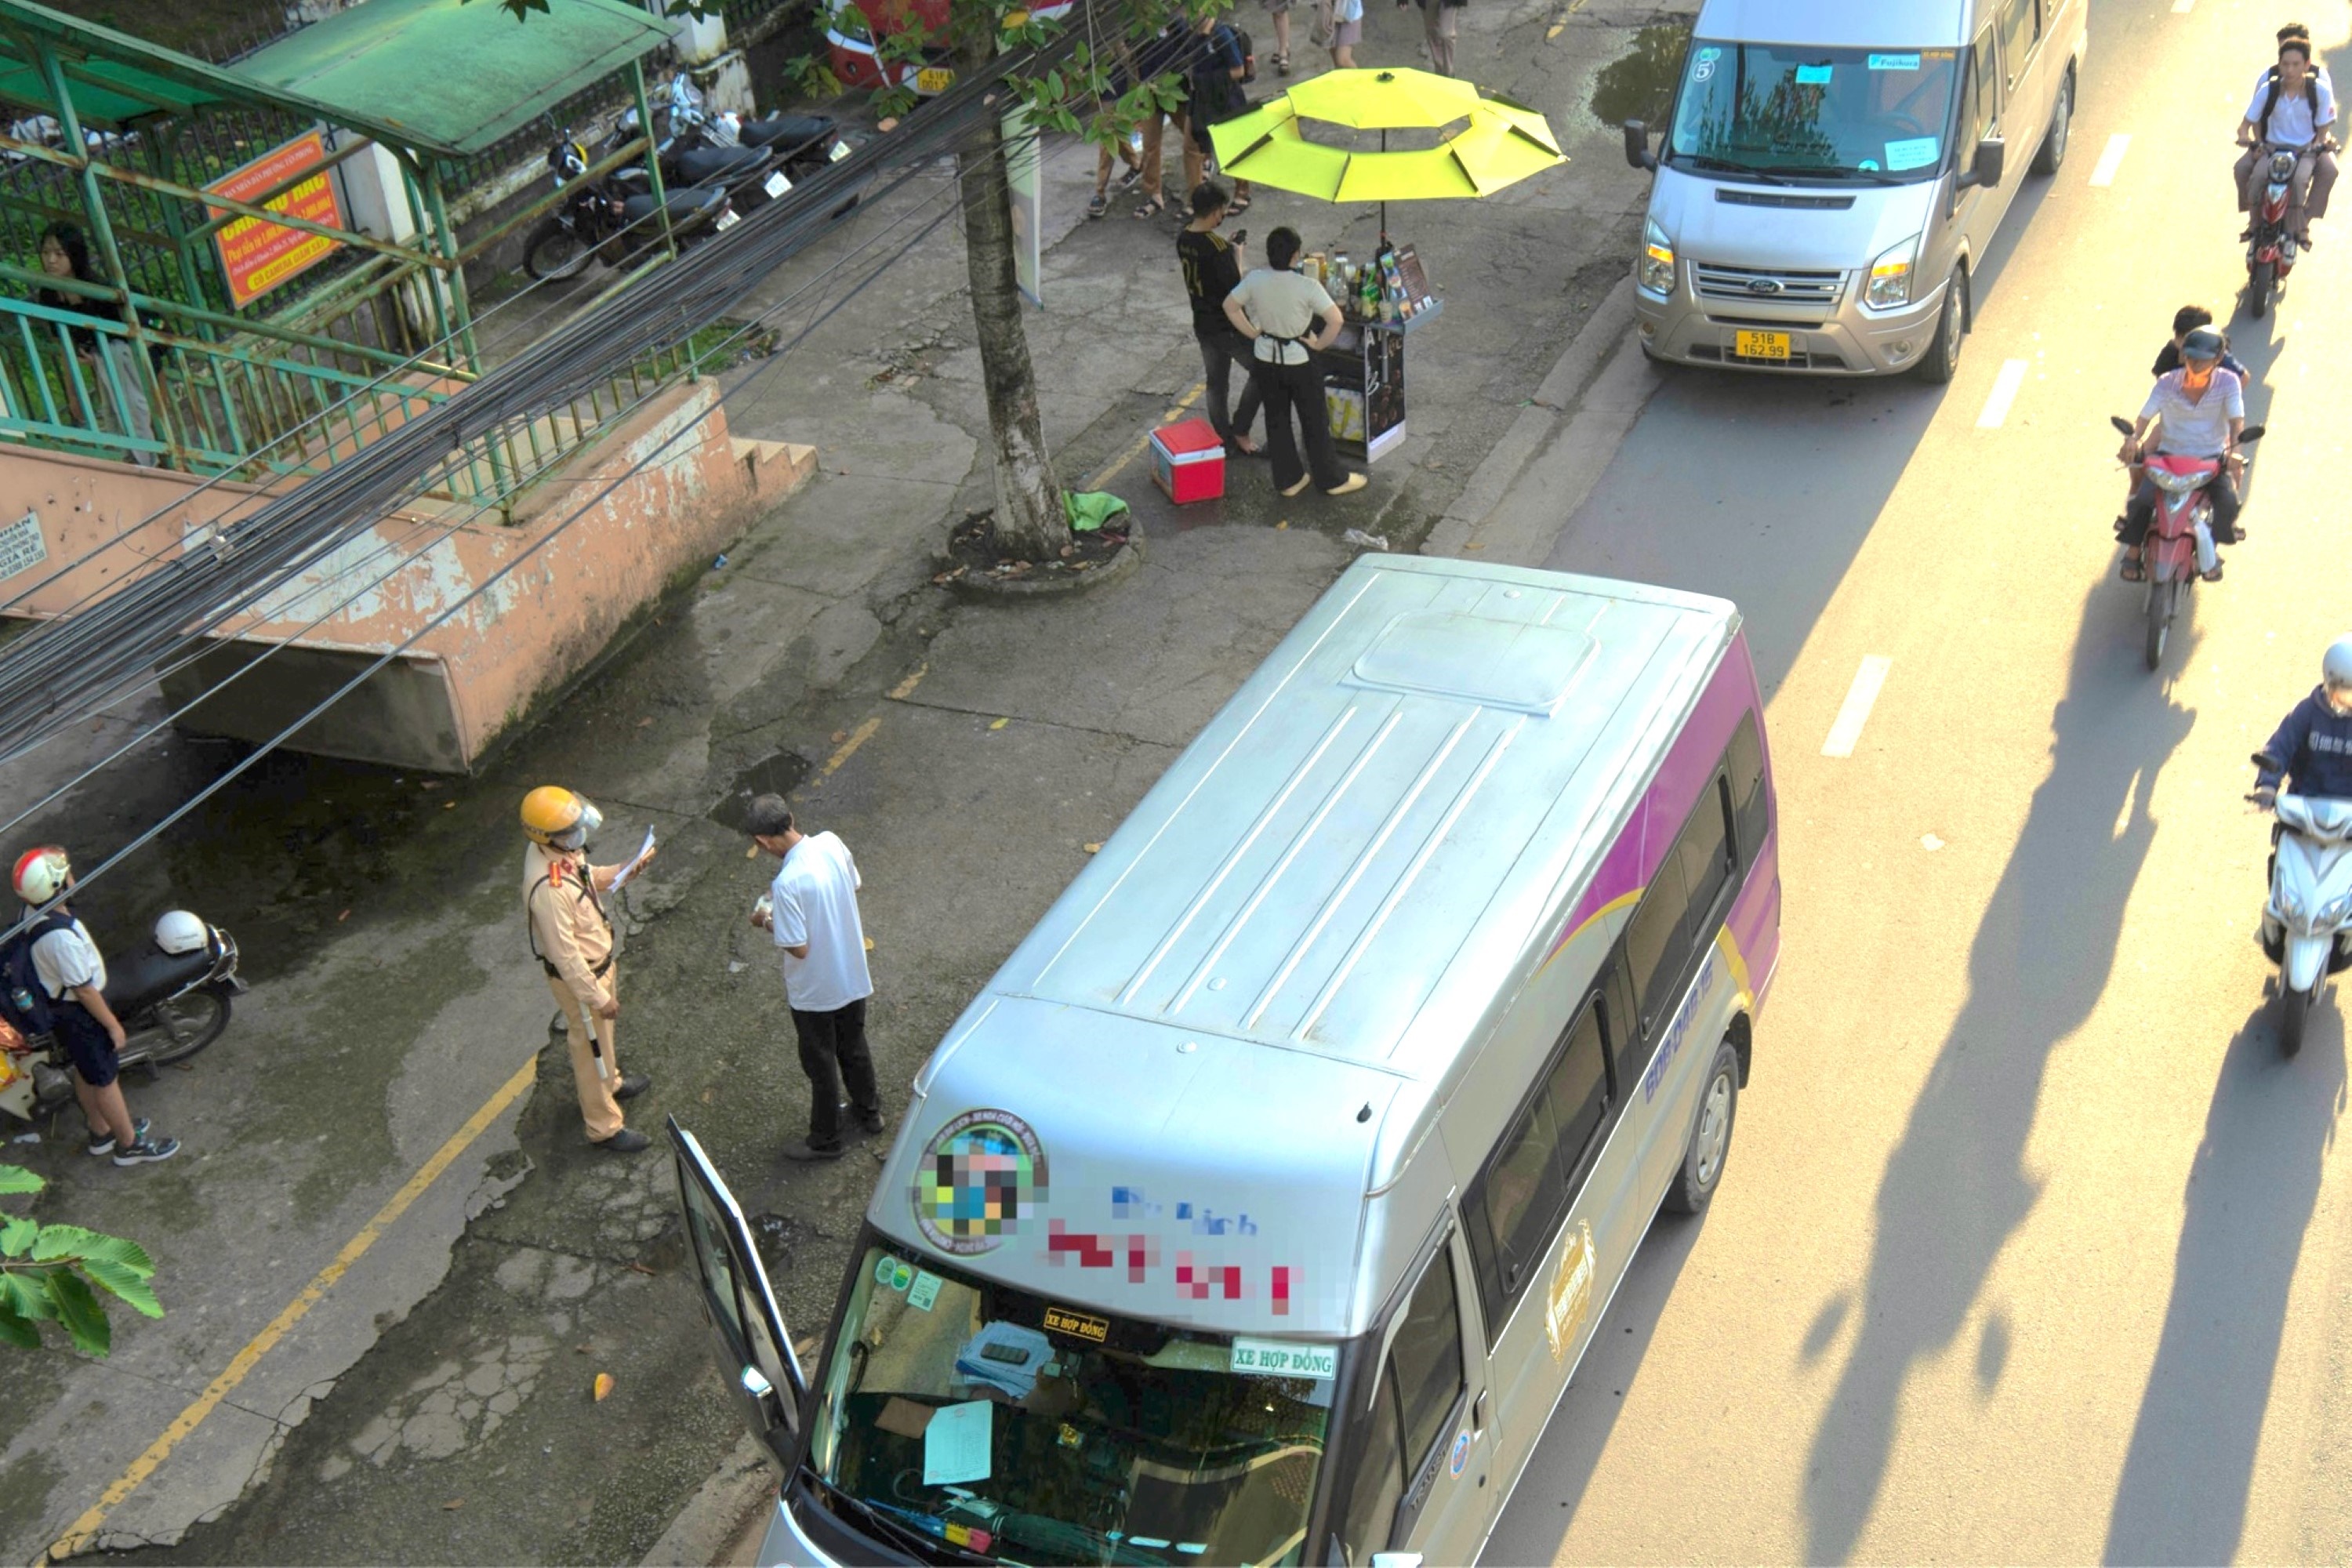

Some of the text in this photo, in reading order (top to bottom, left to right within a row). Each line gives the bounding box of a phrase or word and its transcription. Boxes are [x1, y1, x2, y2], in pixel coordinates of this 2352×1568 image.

[1696, 63, 1710, 79] 5
[1881, 59, 1918, 68] Fujikura
[252, 272, 266, 288] CÓ
[264, 256, 292, 279] CAMERA
[1751, 332, 1775, 345] 51B
[1046, 1314, 1061, 1327] XE
[1060, 1318, 1080, 1331] HỢP
[1236, 1345, 1332, 1373] XE HỢP ĐỒNG
